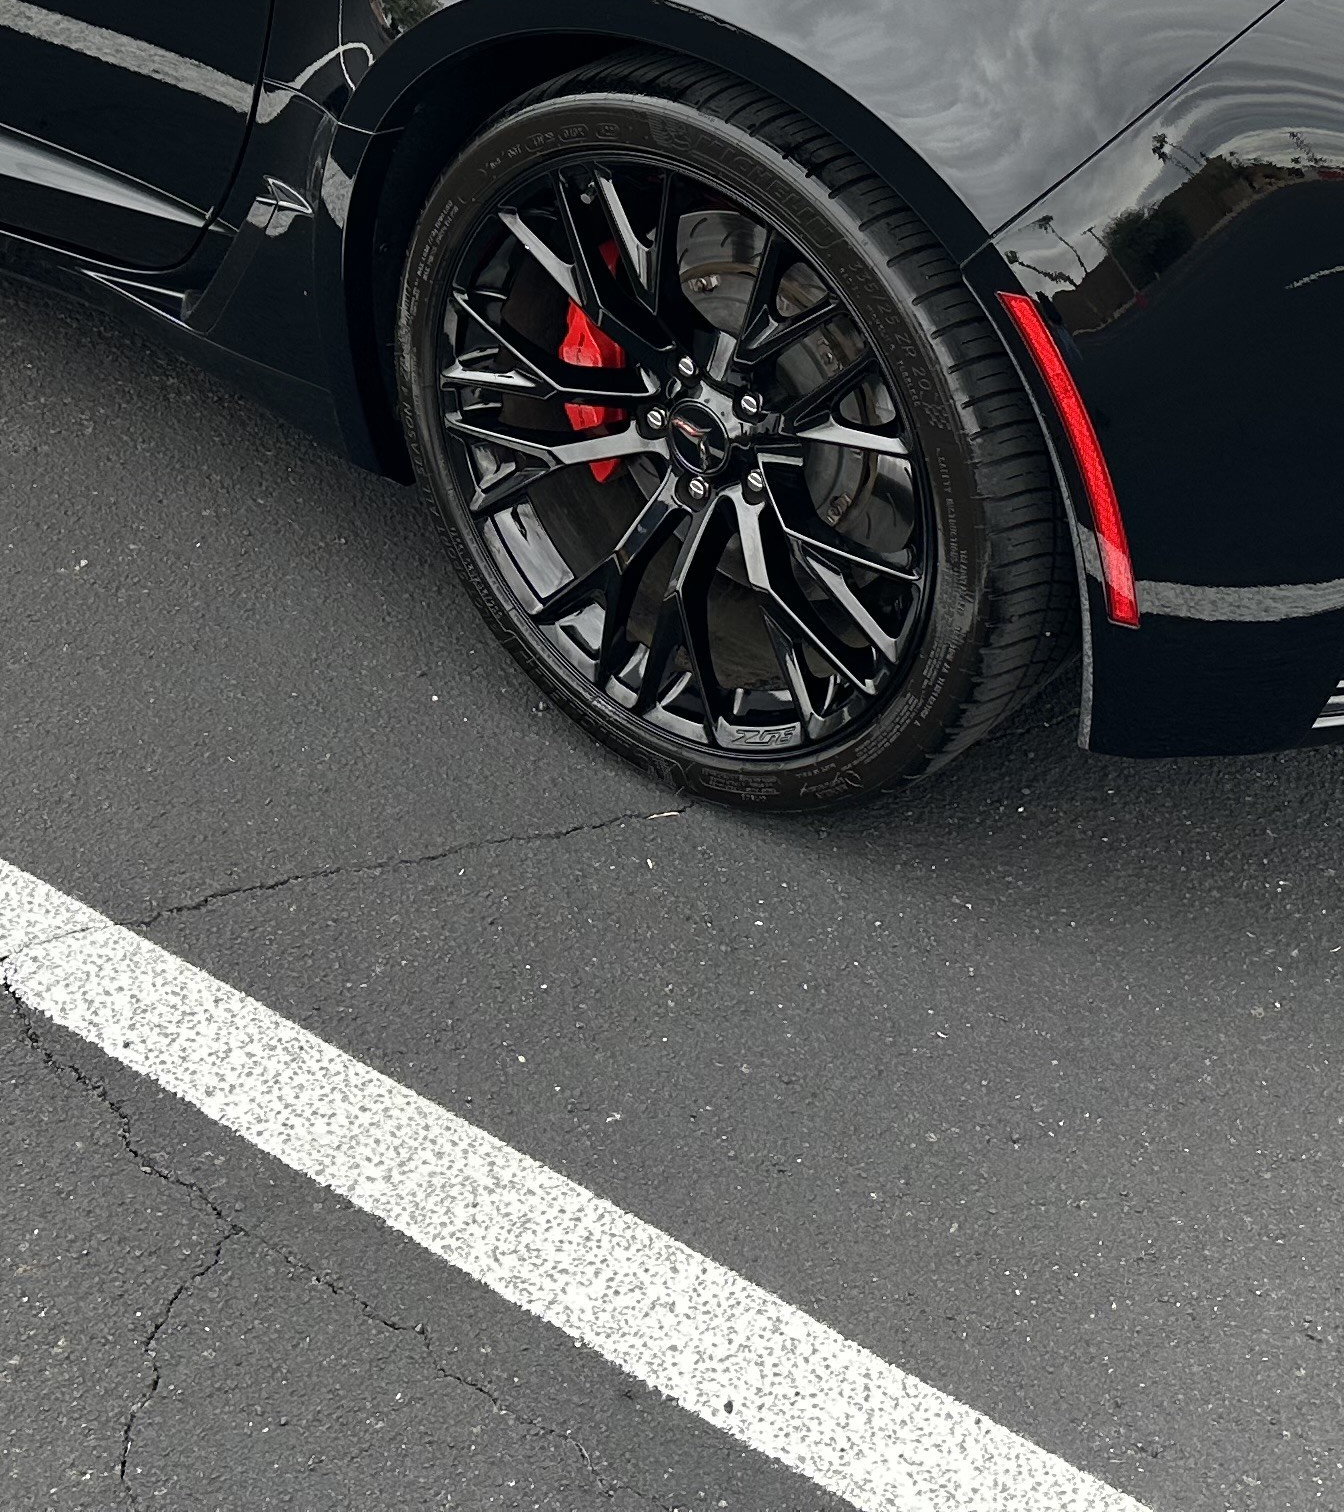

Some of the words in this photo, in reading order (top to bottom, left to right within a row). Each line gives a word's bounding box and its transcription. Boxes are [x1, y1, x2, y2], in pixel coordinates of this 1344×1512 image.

[847, 260, 901, 327] 335/25
[910, 364, 933, 392] 20
[731, 726, 796, 746] Z06
